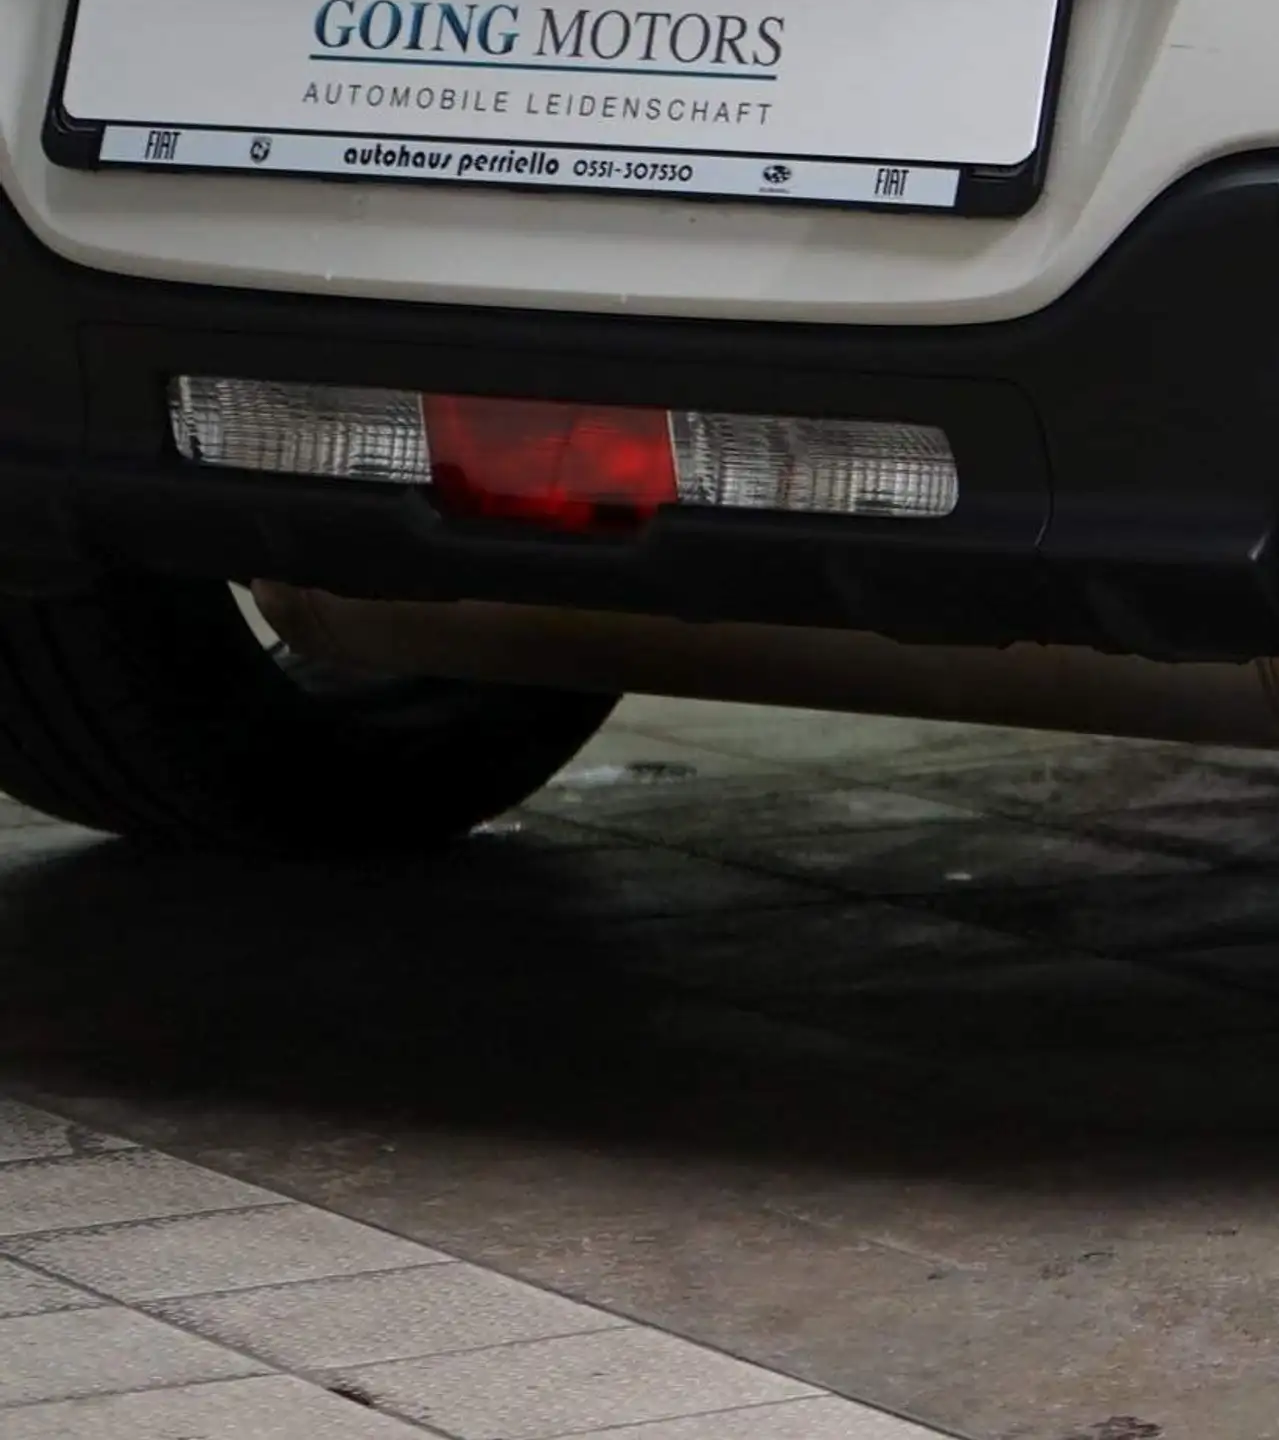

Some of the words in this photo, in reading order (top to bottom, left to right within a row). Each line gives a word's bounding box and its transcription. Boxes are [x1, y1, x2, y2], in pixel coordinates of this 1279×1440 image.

[533, 6, 786, 67] MOTORS
[302, 82, 511, 113] AUTOMOBILE
[526, 93, 774, 126] LEIDENSCHAFT
[144, 130, 182, 161] FIAT
[343, 141, 452, 171] autohaus
[456, 148, 561, 177] perriello
[572, 159, 694, 182] 0551-307530
[874, 168, 911, 196] FIAT
